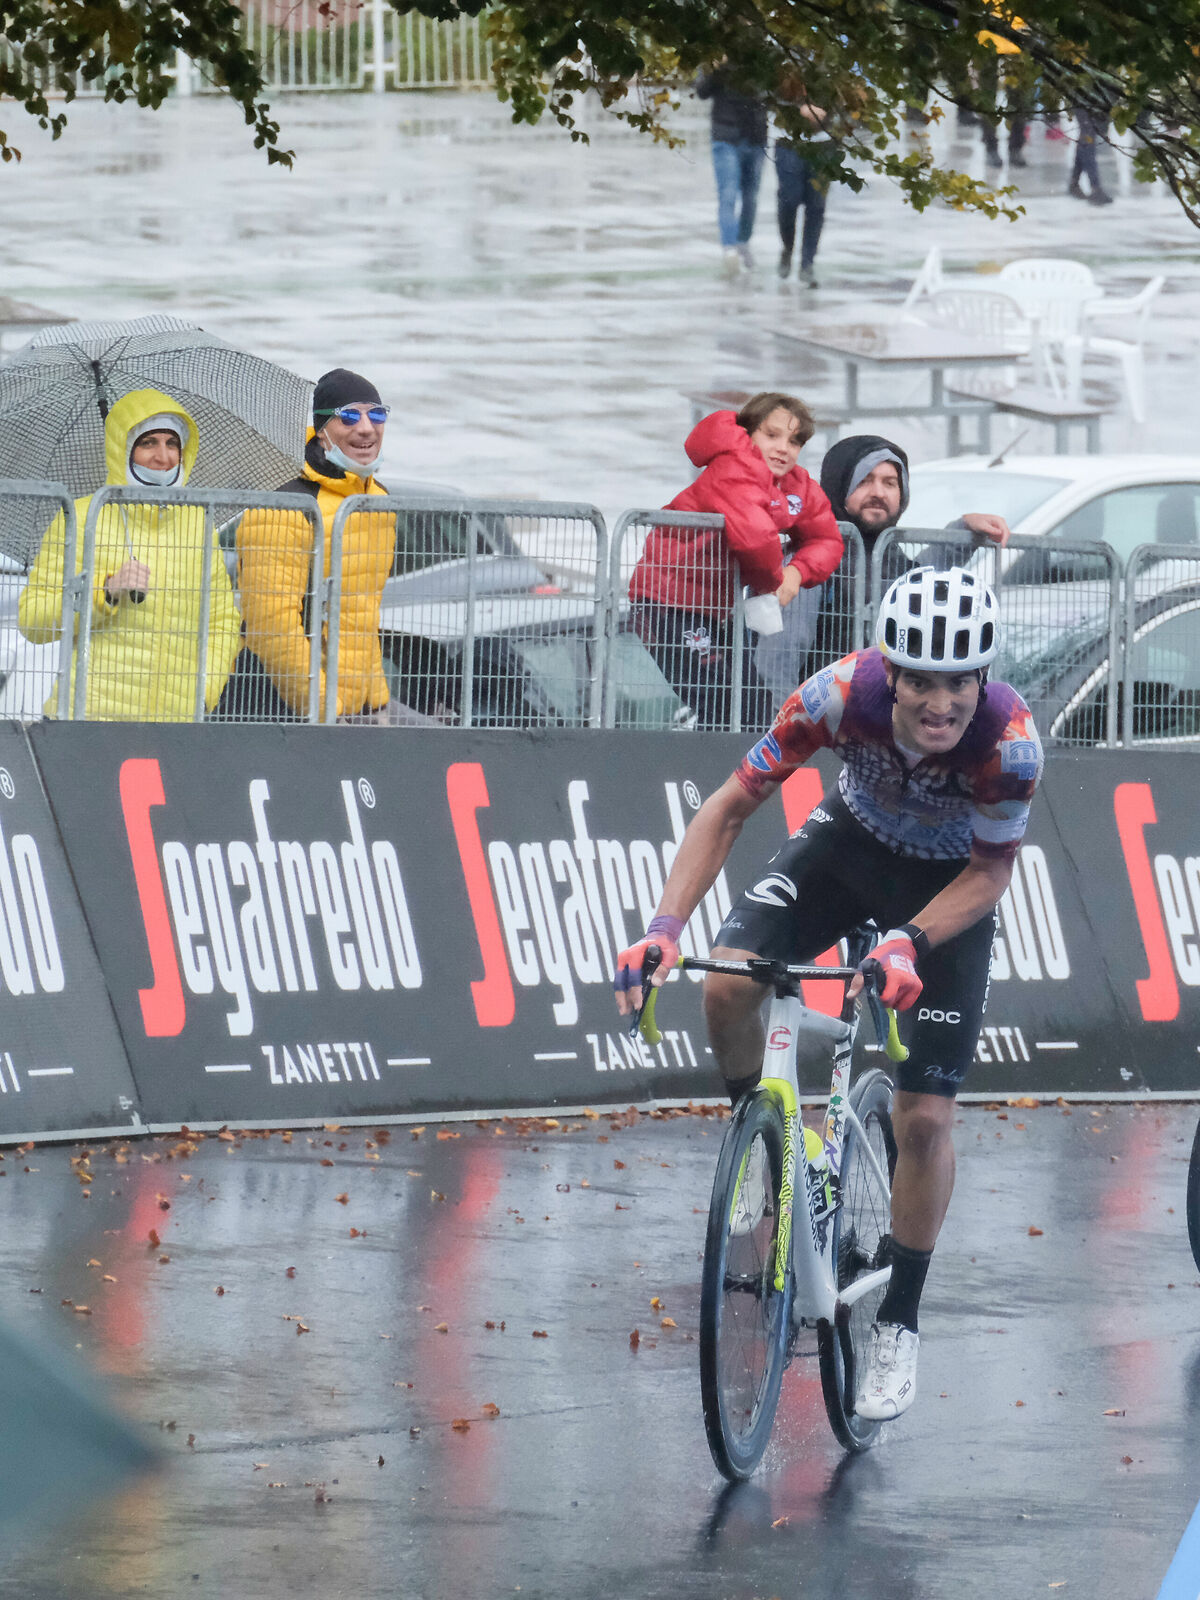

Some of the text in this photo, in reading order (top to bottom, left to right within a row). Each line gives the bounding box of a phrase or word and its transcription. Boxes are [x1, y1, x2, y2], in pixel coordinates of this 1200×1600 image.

[118, 757, 423, 1038] Segafredo
[261, 1042, 381, 1085] ZANETTI
[974, 1026, 1031, 1063] ETTI
